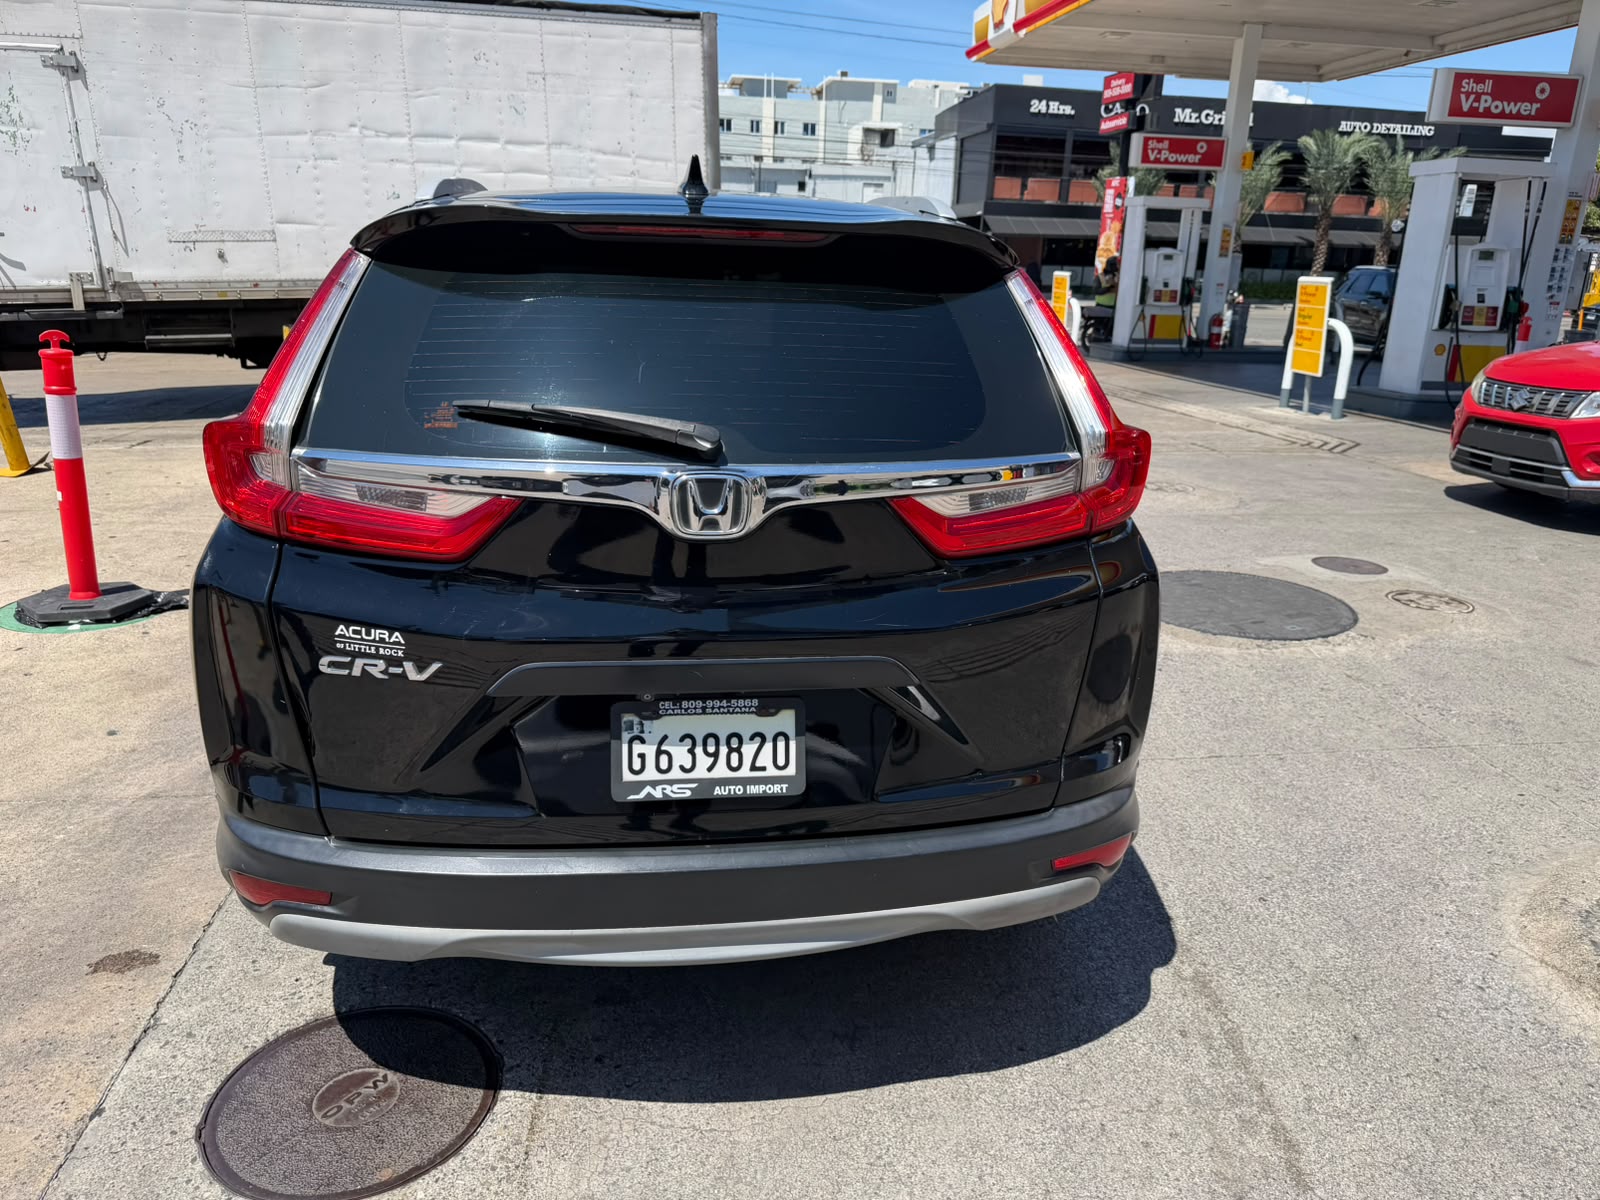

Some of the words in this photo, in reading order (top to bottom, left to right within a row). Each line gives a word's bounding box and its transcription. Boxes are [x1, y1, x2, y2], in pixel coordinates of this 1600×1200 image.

[1461, 78, 1493, 94] Shell
[1029, 99, 1047, 114] 24
[1048, 101, 1075, 116] Hrs.
[1460, 94, 1540, 116] V-Power
[1338, 121, 1371, 134] AUTO
[1372, 123, 1435, 136] DETAILING
[1148, 140, 1169, 150] Shell
[1148, 150, 1202, 163] V-Power
[334, 624, 406, 644] ACURA
[345, 643, 376, 654] LITTLE
[379, 647, 404, 657] ROCK
[318, 655, 443, 681] CR-V
[681, 699, 759, 709] 809-994-5868
[627, 731, 790, 775] G639820
[714, 785, 743, 795] AUTO
[746, 783, 788, 795] IMPORT
